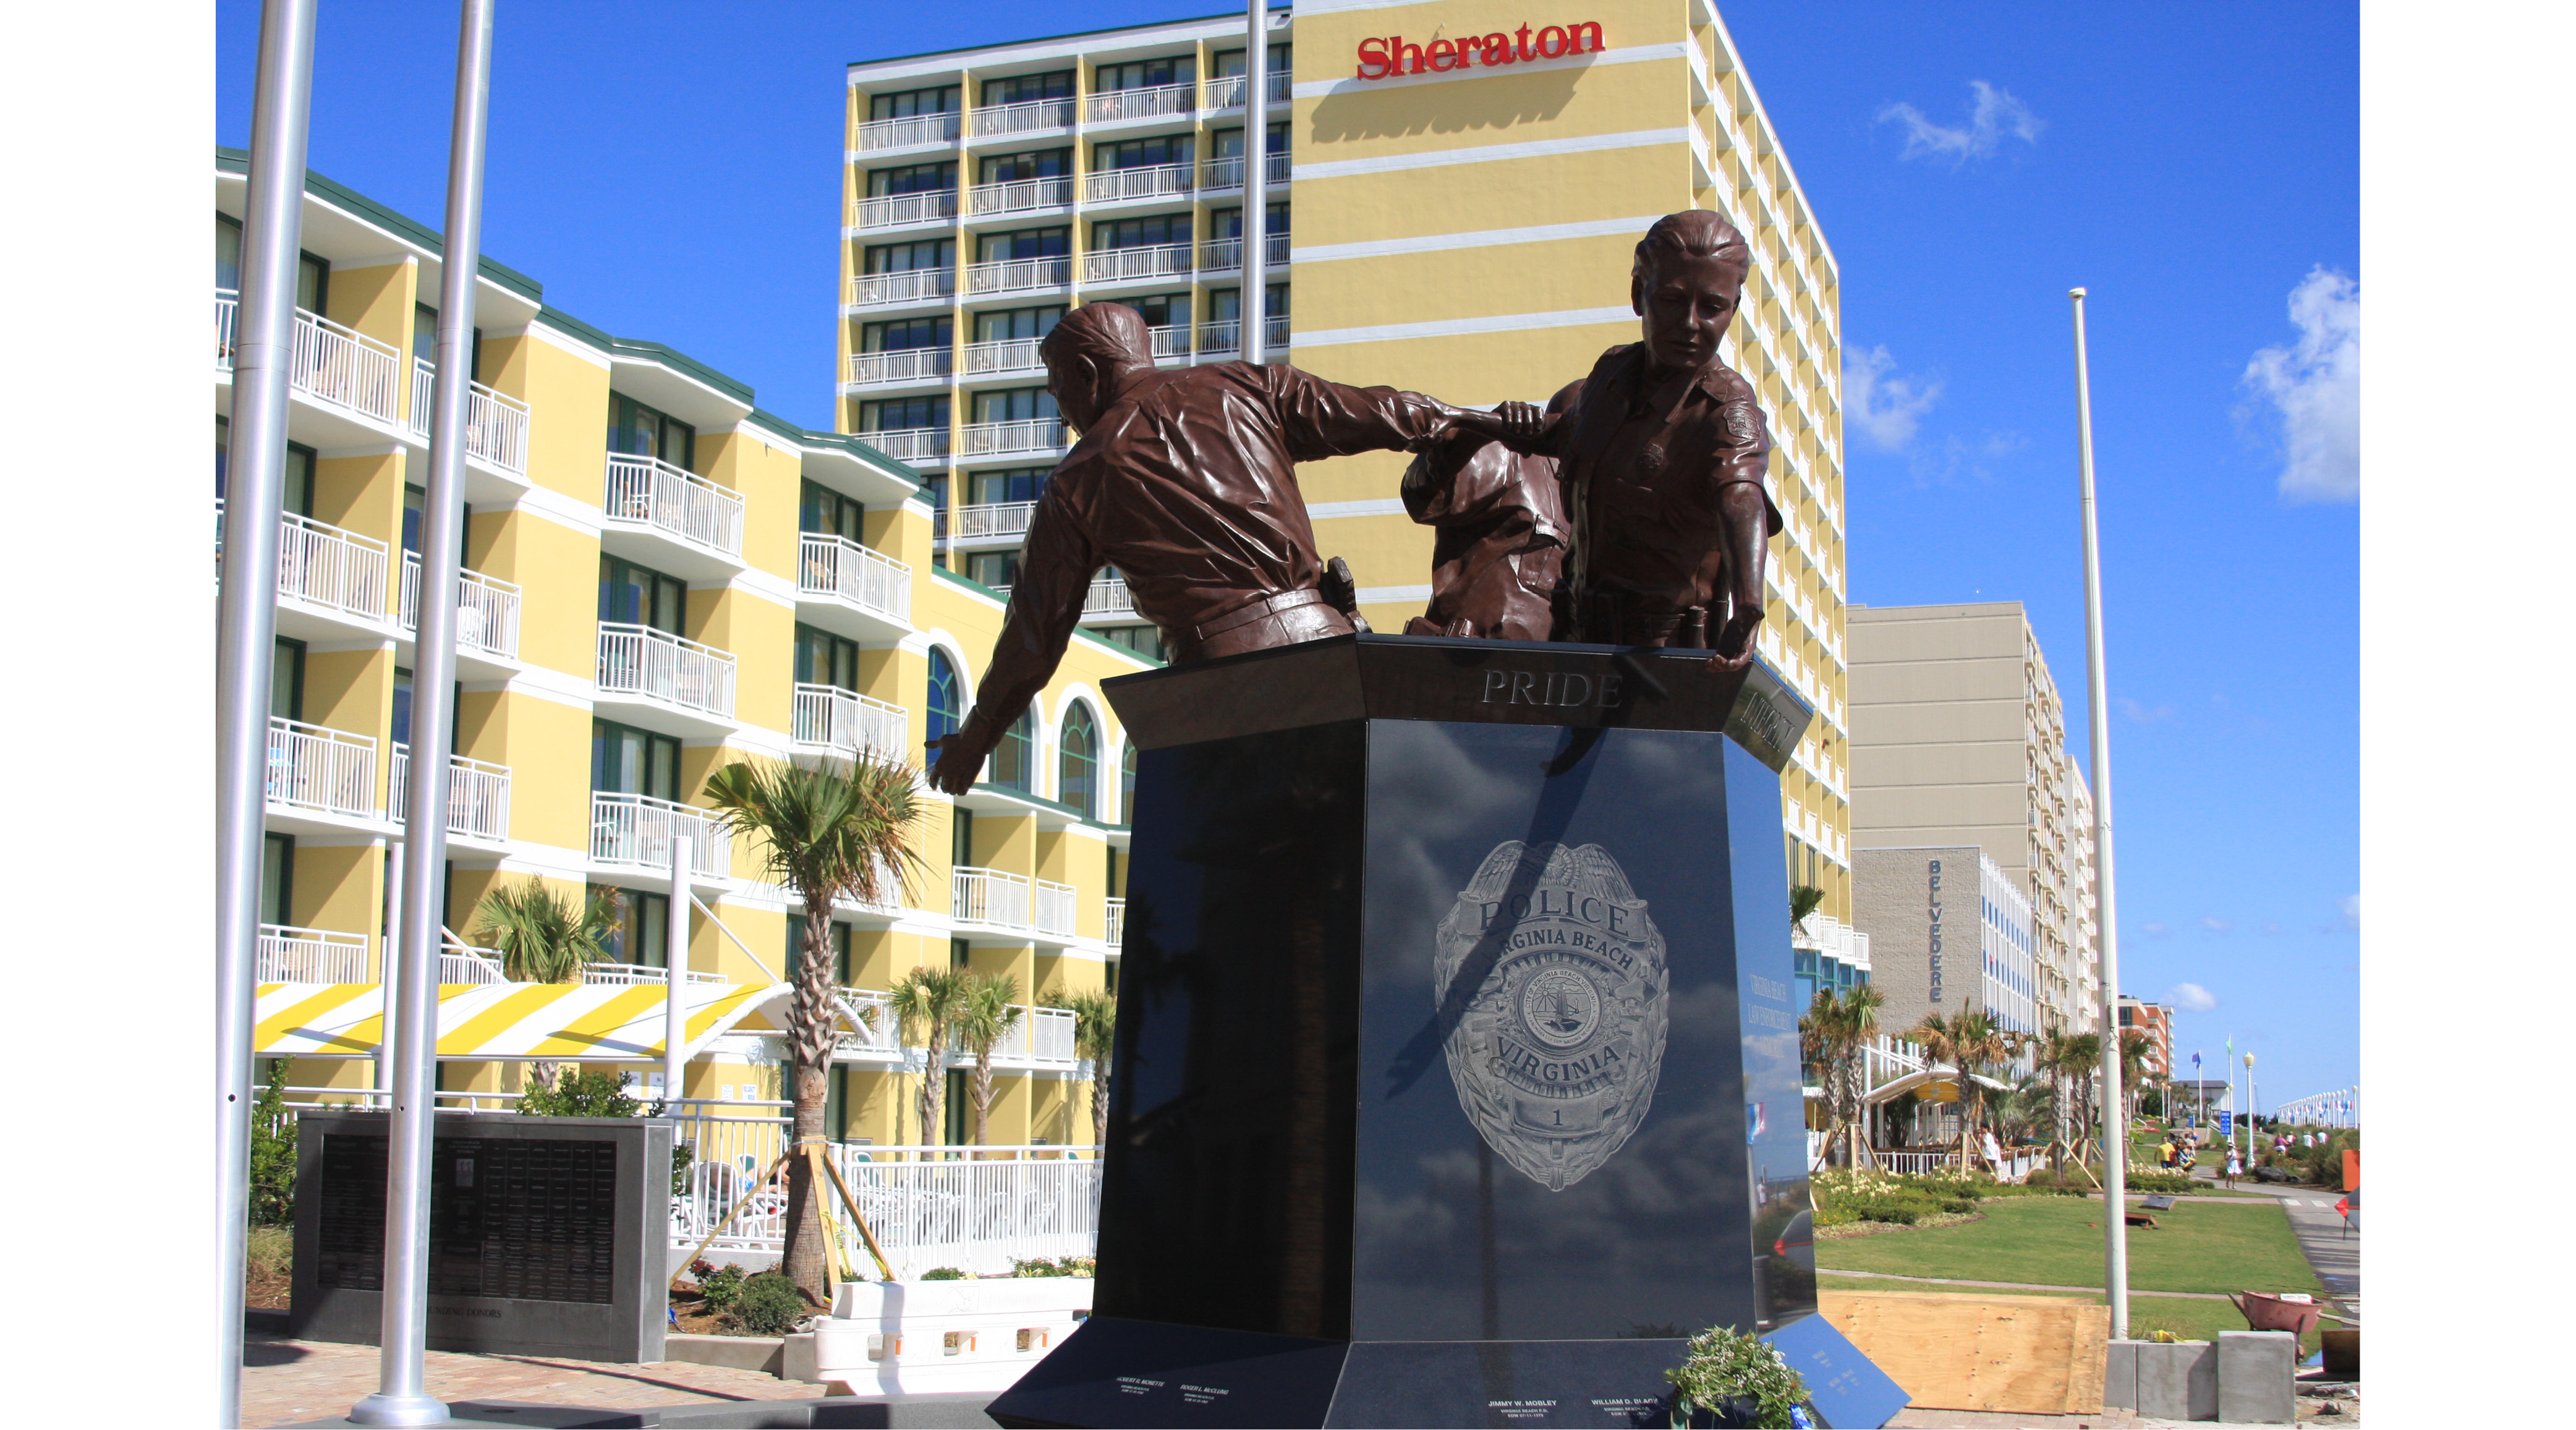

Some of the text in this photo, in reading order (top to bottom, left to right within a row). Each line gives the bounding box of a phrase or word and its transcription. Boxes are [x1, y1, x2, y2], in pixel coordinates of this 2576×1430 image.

[1357, 21, 1606, 80] Sheraton
[1479, 669, 1623, 708] PRIDE
[1479, 890, 1629, 937] POLICE
[1928, 860, 1942, 1003] BELVEDERE
[1492, 929, 1633, 971] RGINIA BEACH
[1532, 971, 1558, 987] VIRGINIA
[1560, 971, 1581, 981] BEACH
[1581, 979, 1597, 1007] VIRGINIA
[1497, 1036, 1621, 1081] VIRGINIA
[1552, 1109, 1562, 1126] 1
[467, 1307, 502, 1317] DONORS
[1203, 1387, 1229, 1395] McCLUNG
